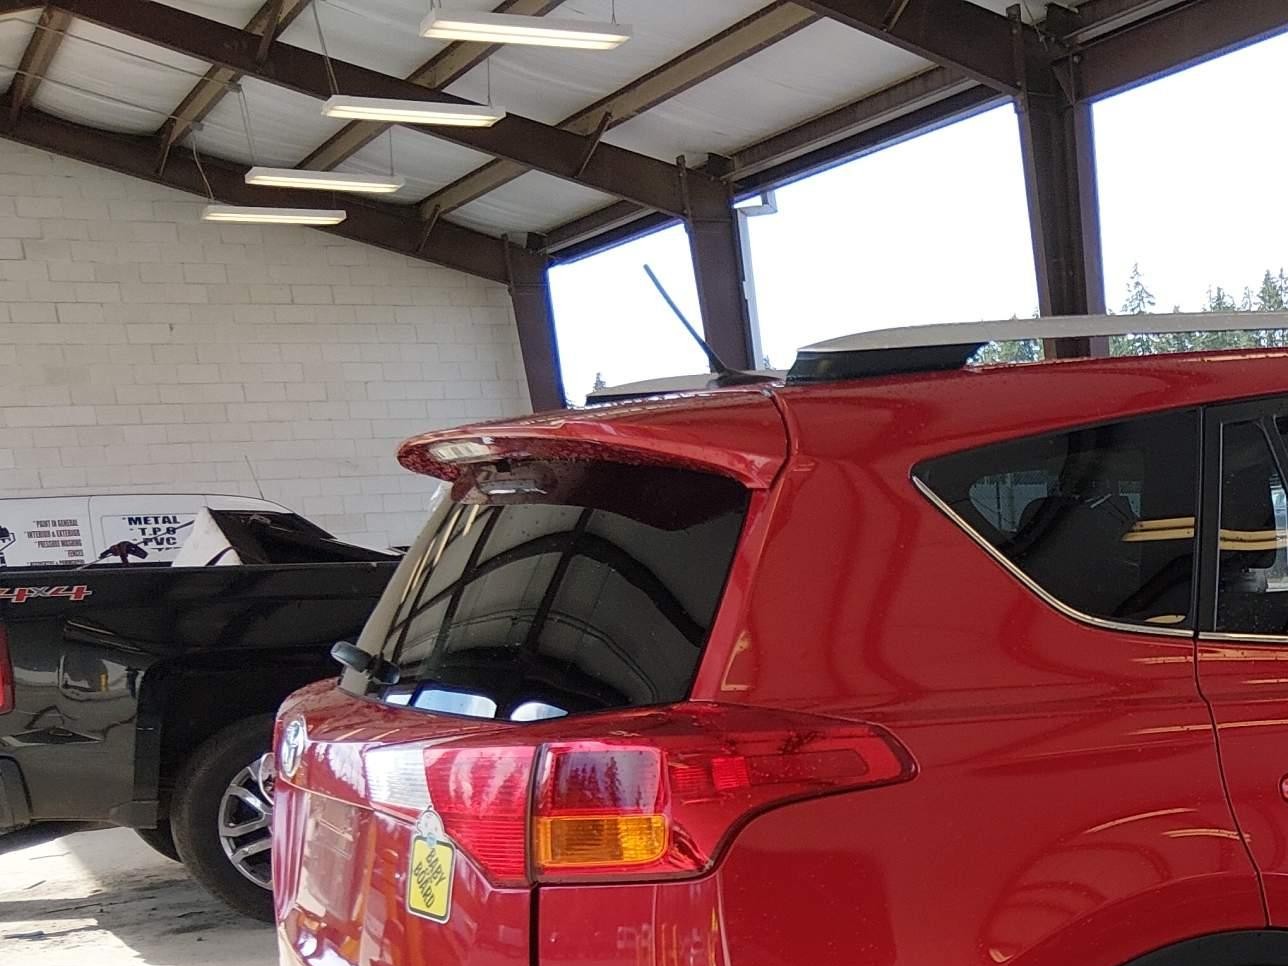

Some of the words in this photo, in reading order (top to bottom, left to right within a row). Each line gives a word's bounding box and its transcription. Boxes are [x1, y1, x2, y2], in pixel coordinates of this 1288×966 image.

[127, 515, 181, 526] METAL
[142, 536, 177, 547] PVC
[426, 847, 446, 886] BABY
[413, 861, 436, 909] BOARD
